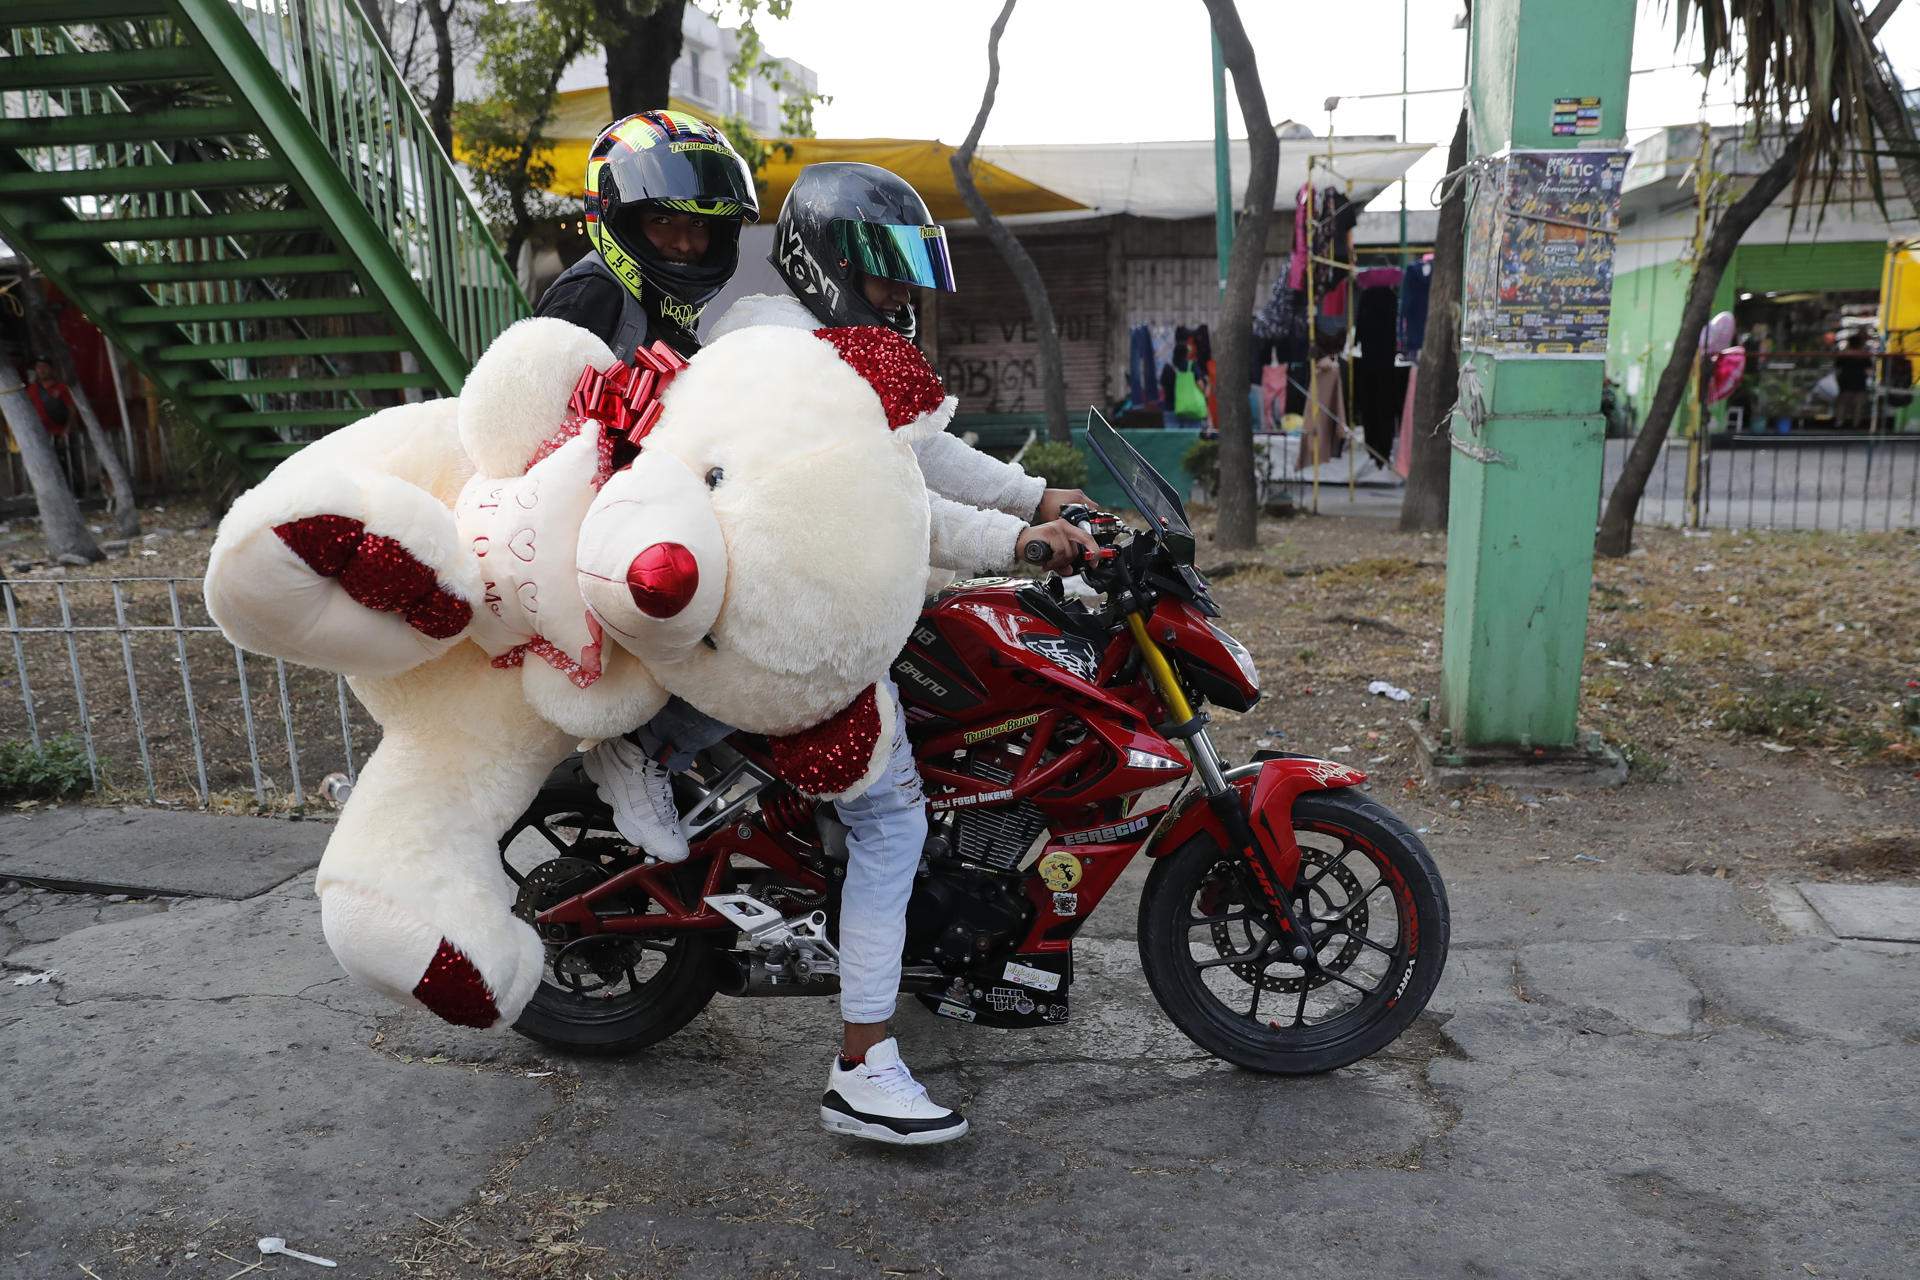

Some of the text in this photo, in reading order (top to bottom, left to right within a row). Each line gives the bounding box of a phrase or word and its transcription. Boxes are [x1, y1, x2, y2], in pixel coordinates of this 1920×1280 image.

[896, 660, 949, 697] BRUNO
[964, 727, 992, 744] TRIBU
[1006, 714, 1039, 732] BRUNO
